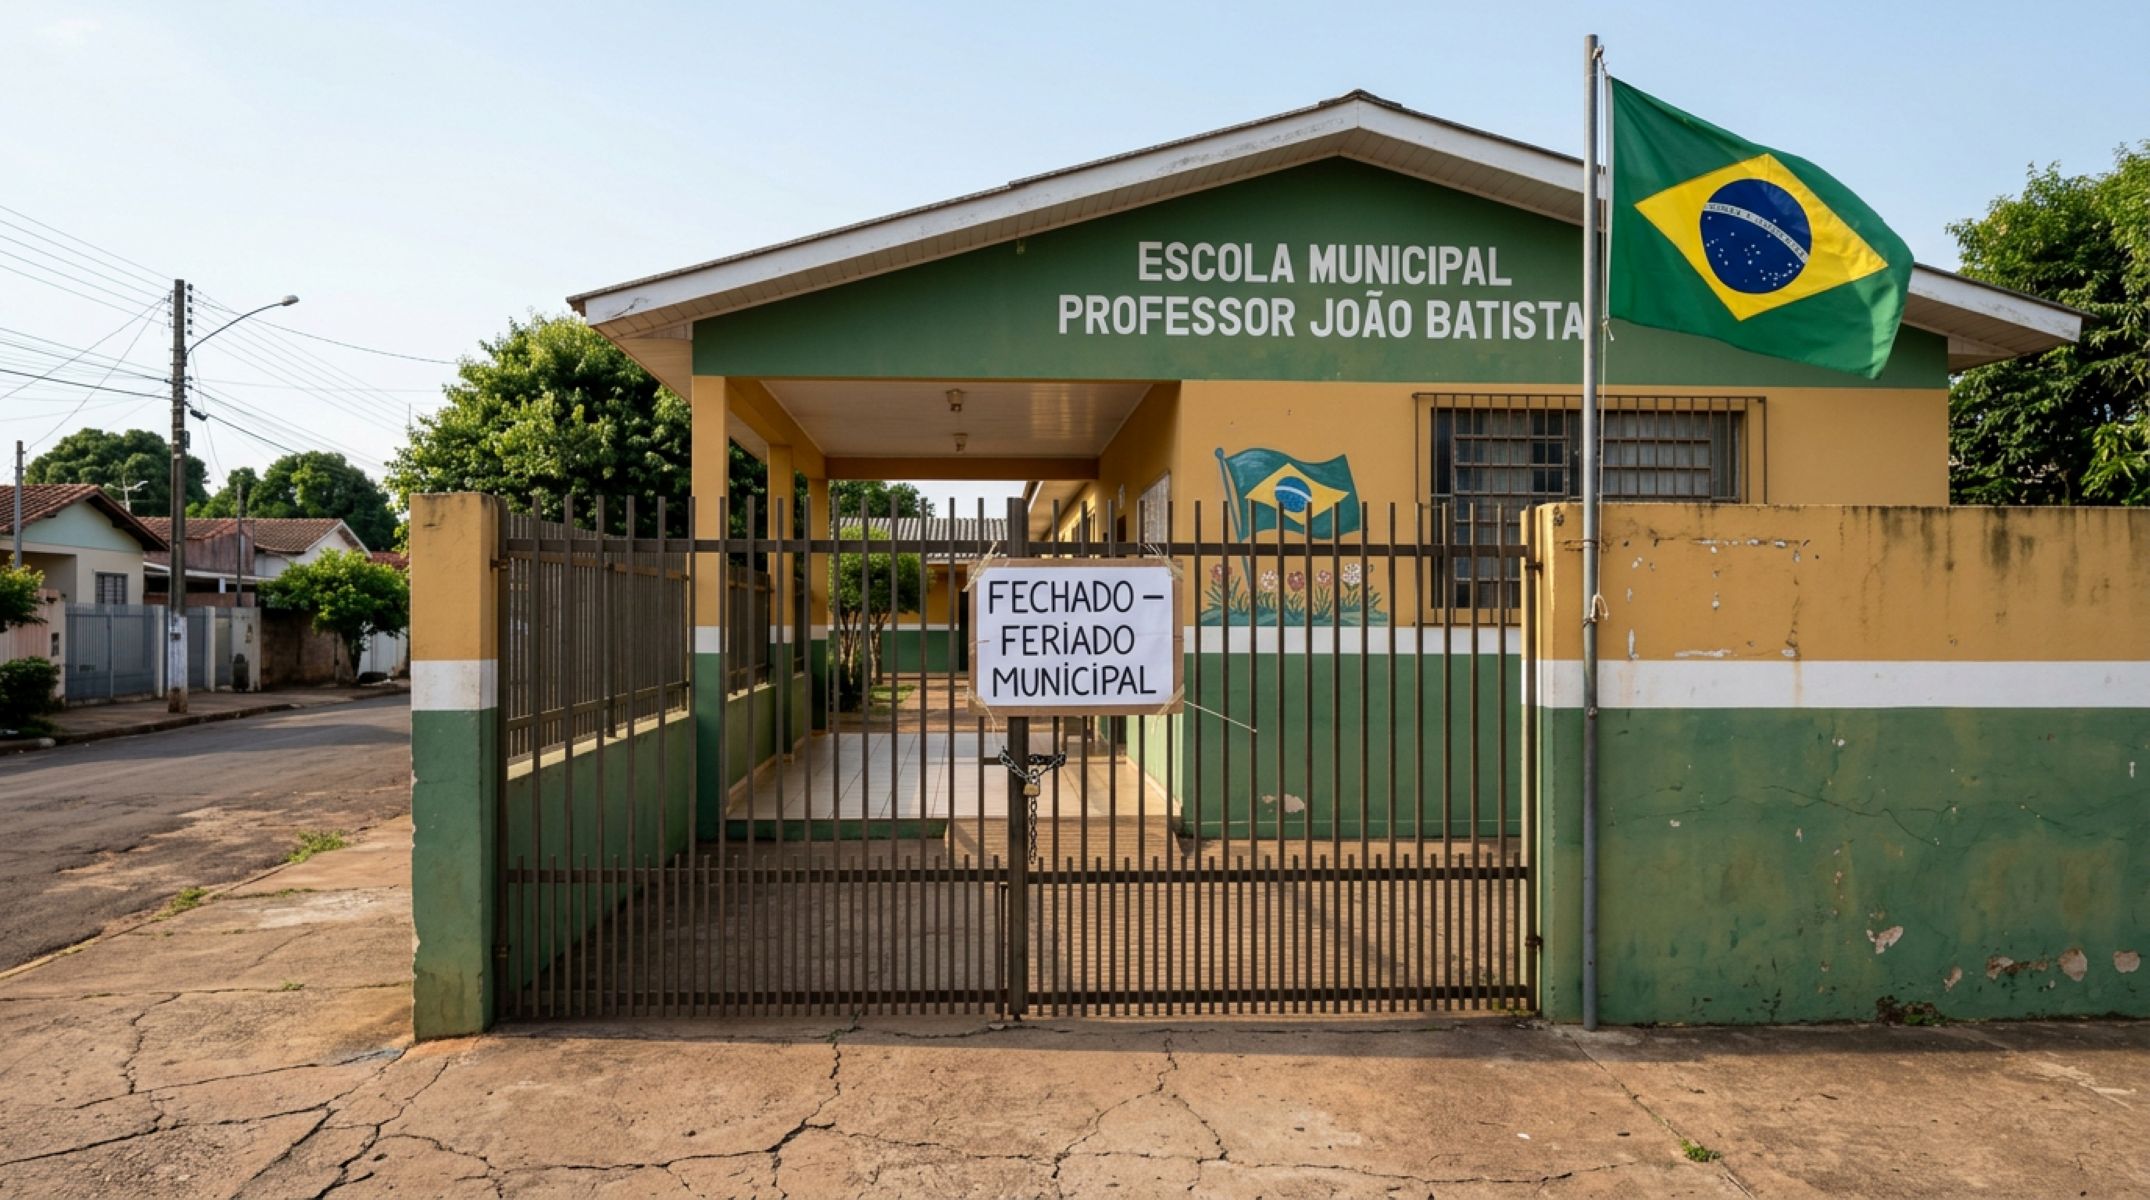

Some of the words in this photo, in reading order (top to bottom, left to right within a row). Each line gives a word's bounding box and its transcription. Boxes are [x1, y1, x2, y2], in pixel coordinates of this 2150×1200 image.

[1138, 241, 1296, 284] ESCOLA
[1308, 244, 1513, 287] MUNICIPAL
[1058, 294, 1296, 337] PROFESSOR
[1309, 289, 1413, 339] JOÃO
[1426, 299, 1585, 341] BATISTA
[988, 579, 1135, 615] FECHADO
